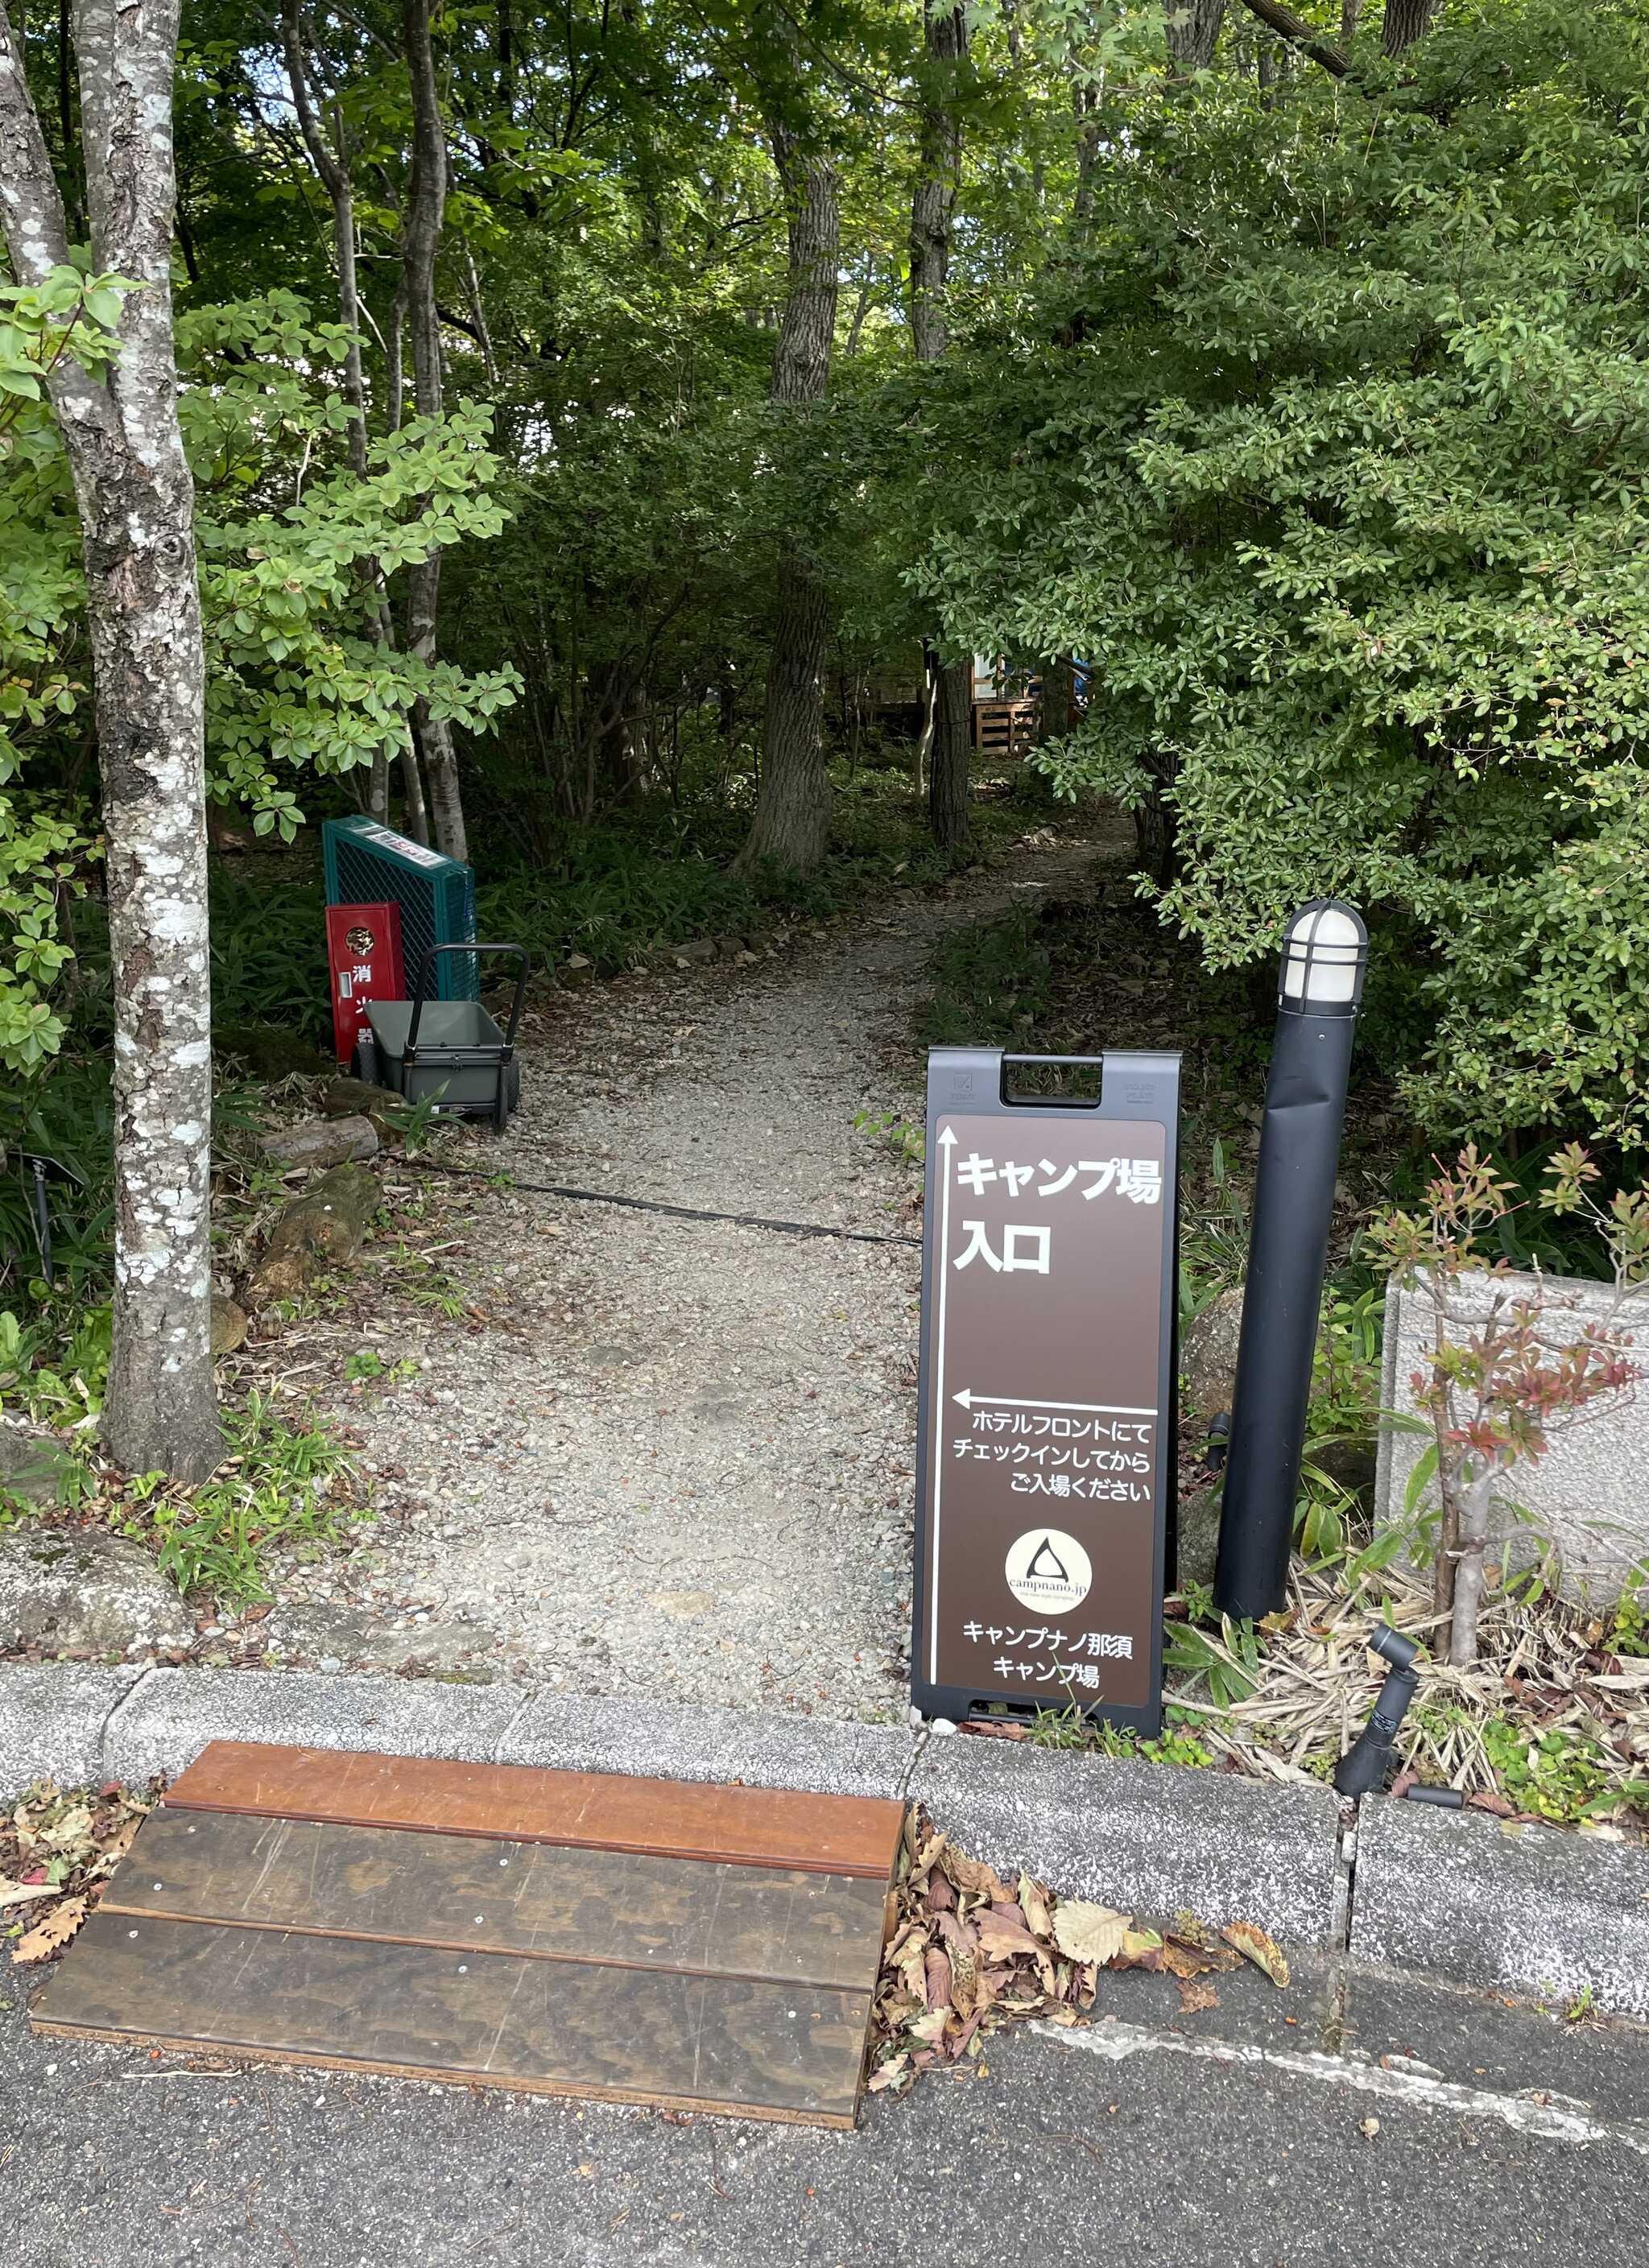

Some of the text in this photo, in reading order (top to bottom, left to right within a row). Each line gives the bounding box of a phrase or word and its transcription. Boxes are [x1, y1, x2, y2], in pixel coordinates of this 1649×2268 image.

[957, 1152, 1162, 1204] キャンプ場
[953, 1221, 1051, 1274] 入口
[973, 1411, 1152, 1444] ホテルフロントにて
[953, 1439, 1150, 1473] チェックインしてから
[1010, 1473, 1151, 1502] ご入場ください
[1009, 1579, 1087, 1597] campnano.jp
[963, 1621, 1133, 1660] キャンプナノ那須
[994, 1656, 1100, 1689] キャンプ場
